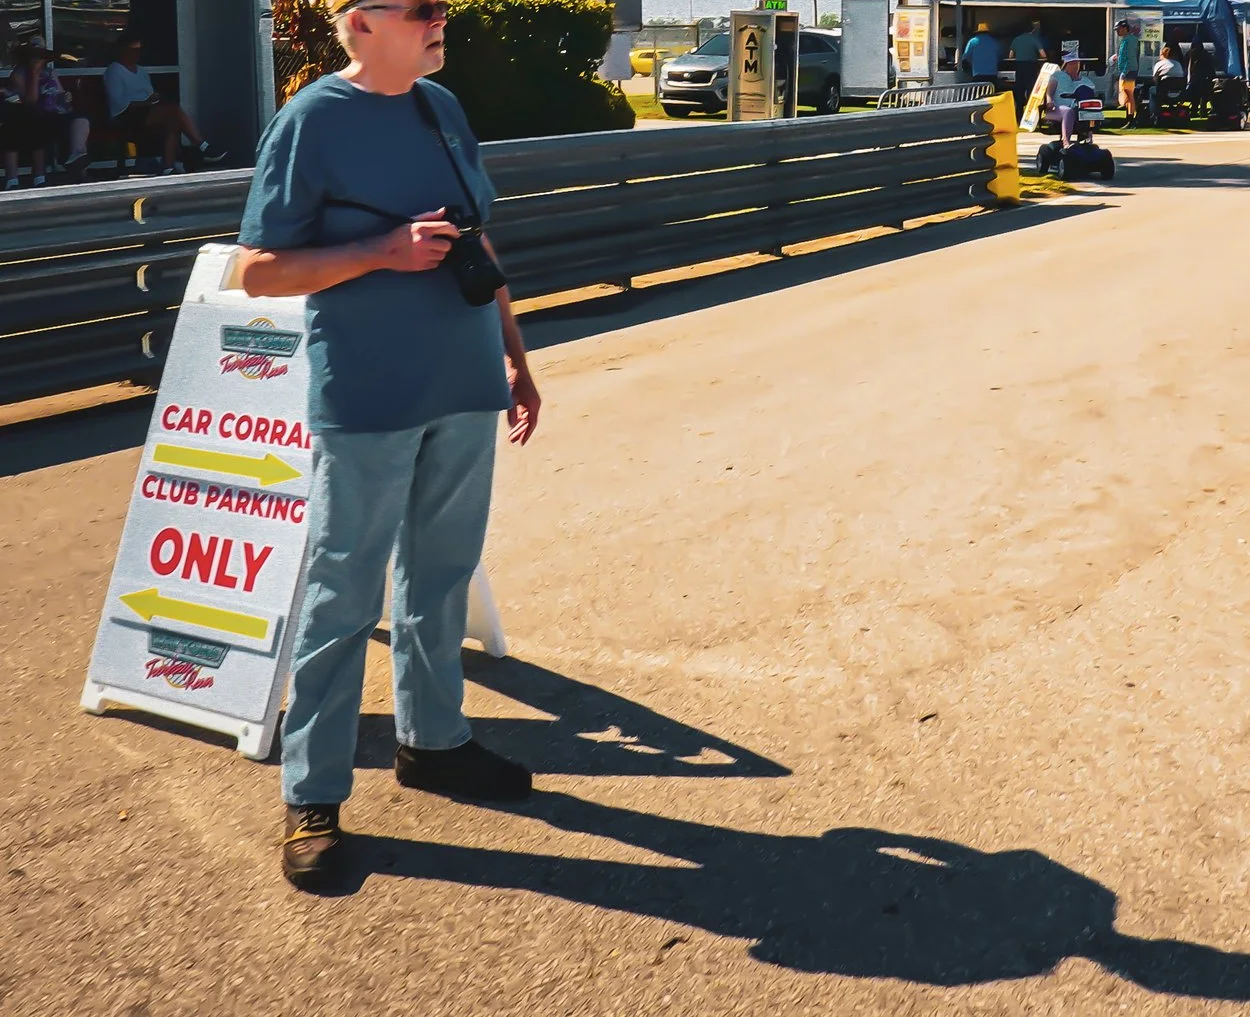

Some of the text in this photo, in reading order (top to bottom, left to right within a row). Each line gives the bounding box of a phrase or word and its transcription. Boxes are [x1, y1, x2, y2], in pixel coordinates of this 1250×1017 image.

[765, 0, 787, 10] ATM
[744, 32, 759, 74] ATM
[162, 405, 212, 435] CAR
[142, 475, 306, 524] CLUB PARKING
[150, 527, 273, 593] ONLY
